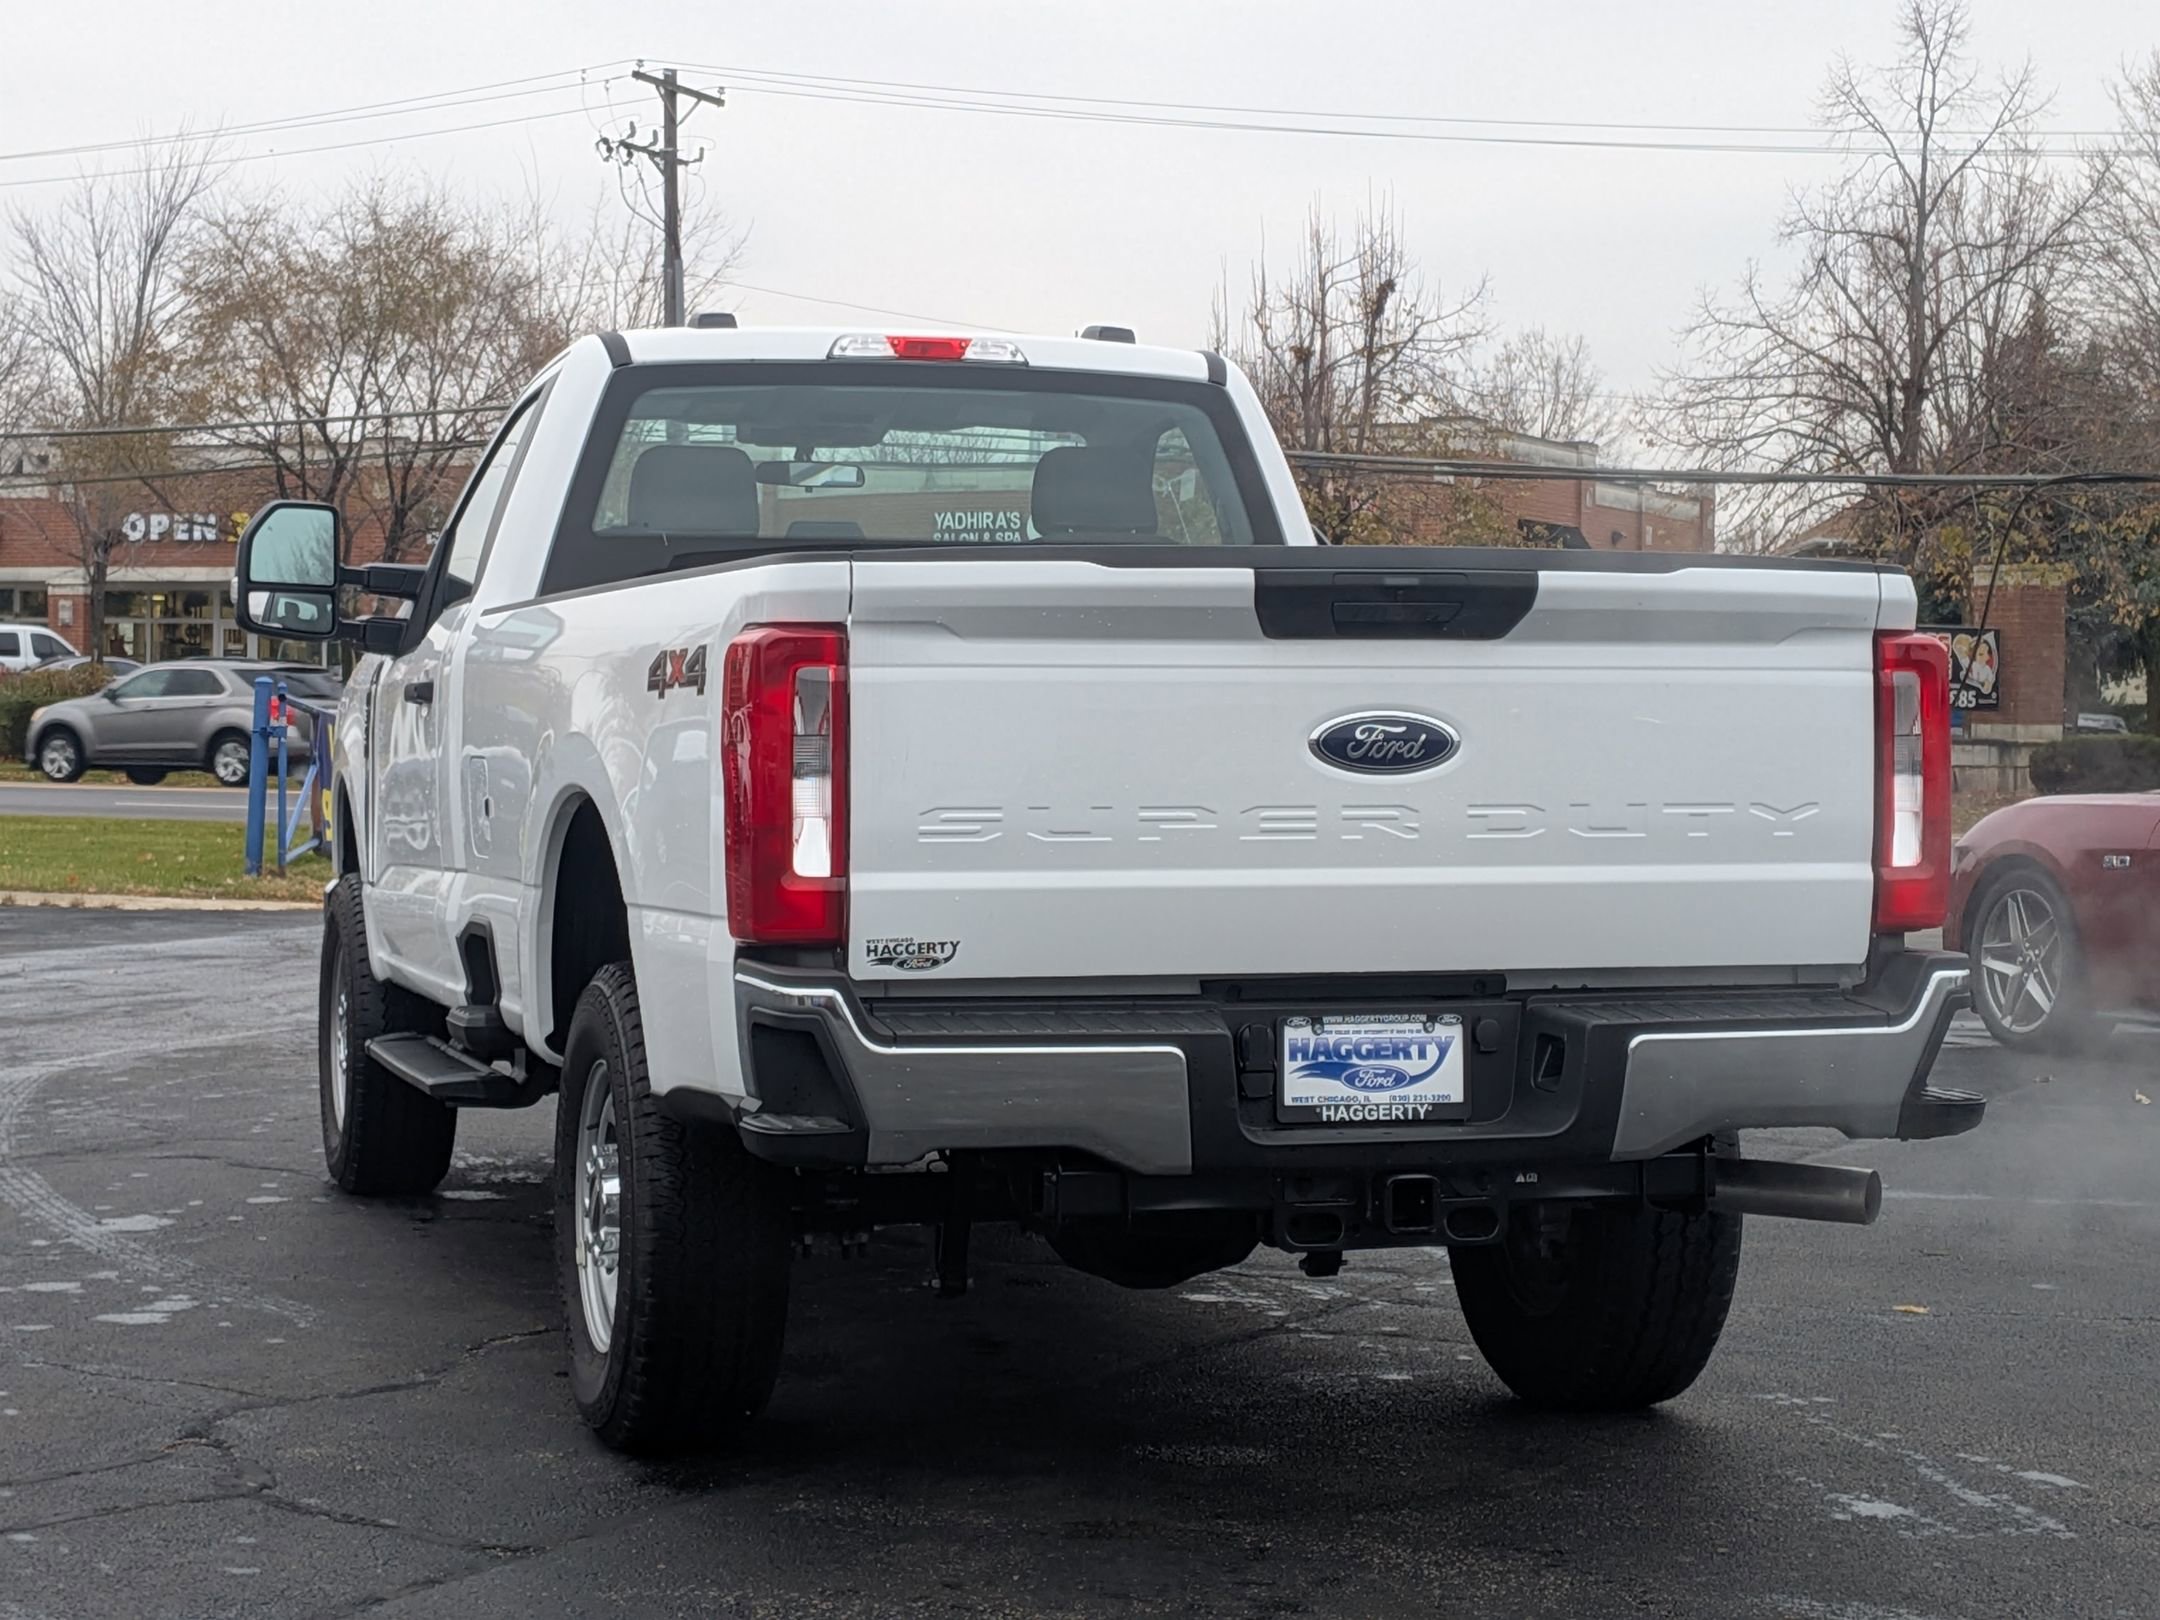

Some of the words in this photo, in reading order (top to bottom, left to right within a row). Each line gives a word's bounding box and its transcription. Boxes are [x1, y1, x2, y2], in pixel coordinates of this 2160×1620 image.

[122, 512, 217, 542] OPEN
[934, 511, 1021, 530] YADHIRA'S
[1346, 723, 1427, 761] Ford
[918, 804, 1420, 843] SUPER
[1466, 802, 1820, 839] DUTY
[866, 940, 960, 958] HAGGERTY
[1288, 1036, 1456, 1063] HAGGERTY
[1354, 1069, 1397, 1088] Ford
[1291, 1096, 1316, 1104] WEST
[1321, 1104, 1428, 1122] HAGGERTY
